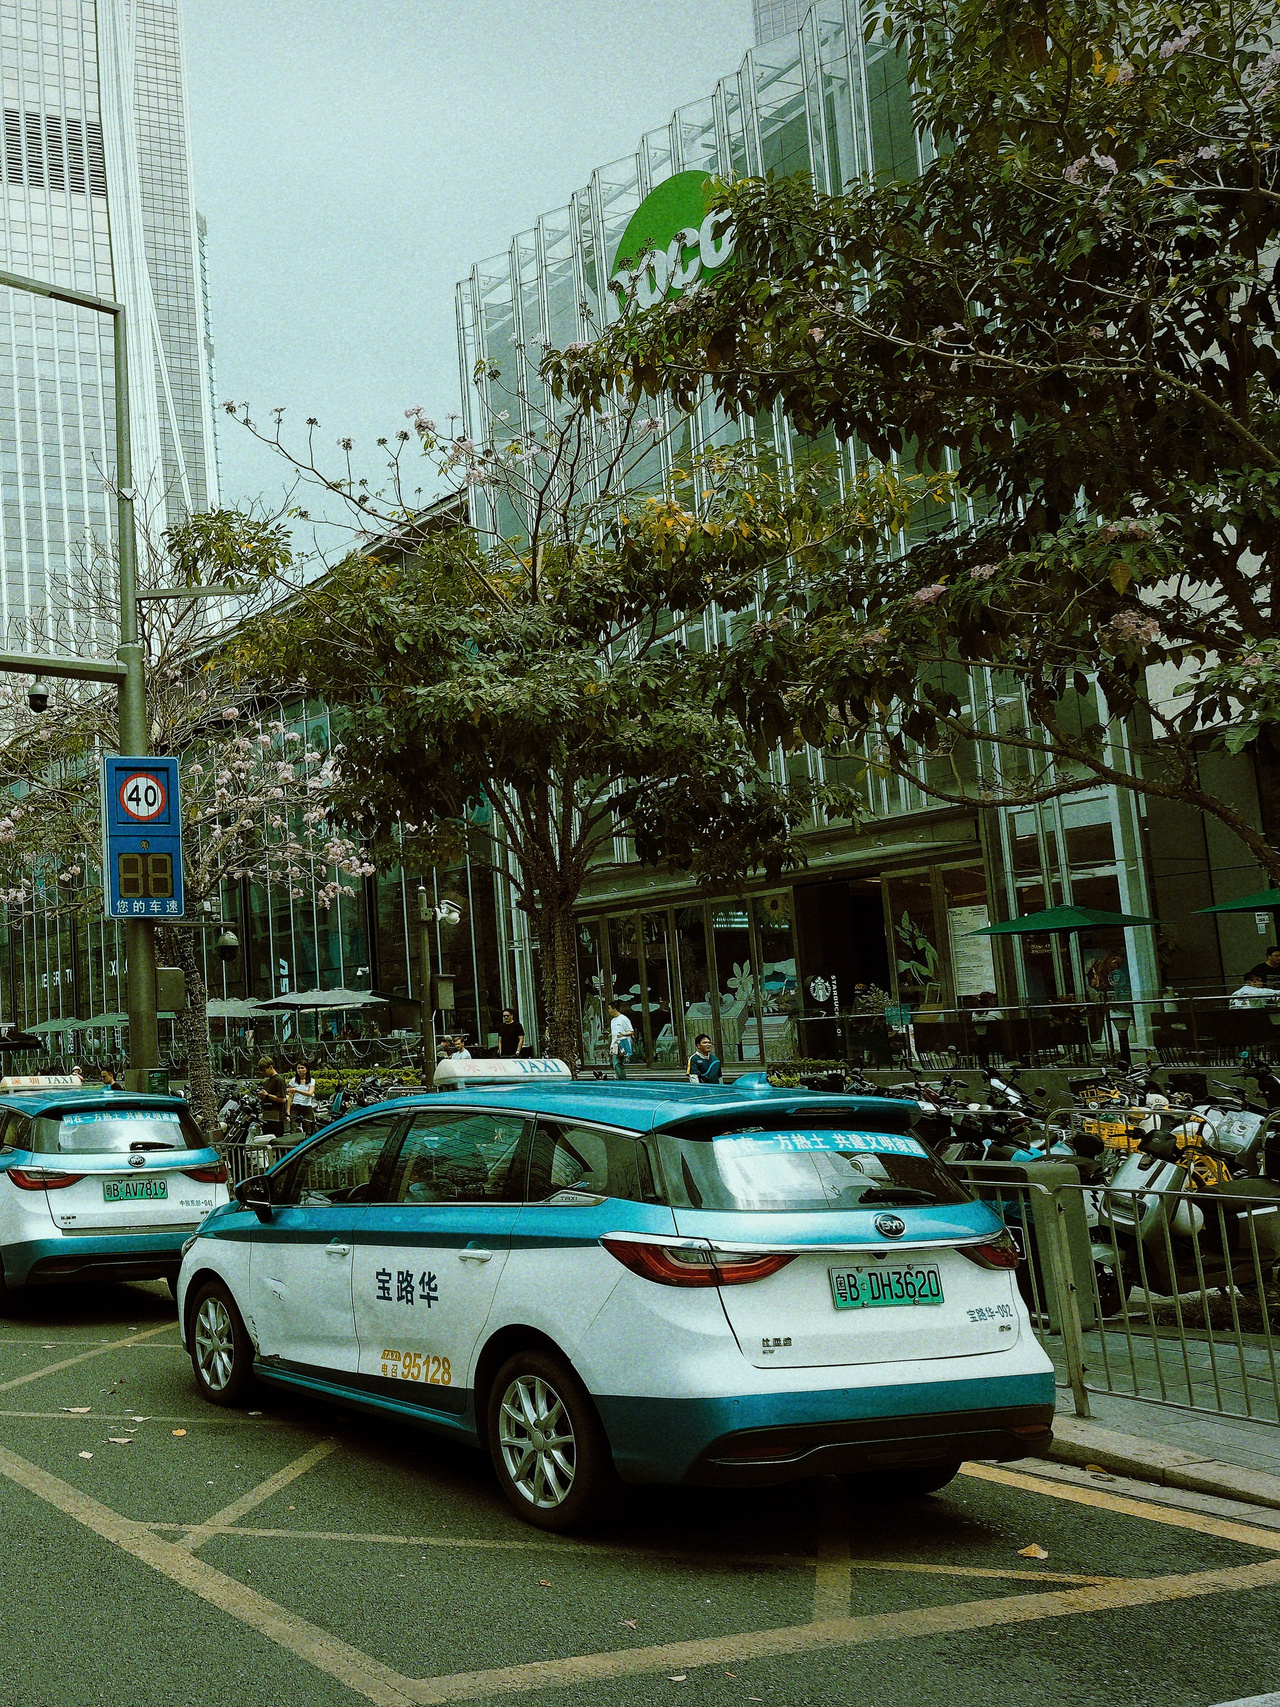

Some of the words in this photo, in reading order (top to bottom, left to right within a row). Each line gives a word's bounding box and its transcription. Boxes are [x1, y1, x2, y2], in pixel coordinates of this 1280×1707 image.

[127, 784, 157, 807] 40
[116, 900, 179, 914] 您的车速
[513, 1060, 562, 1074] TAXI
[11, 1077, 40, 1085] 深圳
[45, 1076, 74, 1084] TAXI
[832, 1133, 924, 1156] 共建文明家园
[376, 1268, 439, 1308] 宝路华
[384, 1350, 400, 1360] TAXI
[381, 1363, 398, 1378] 电召
[401, 1352, 452, 1386] 95128
